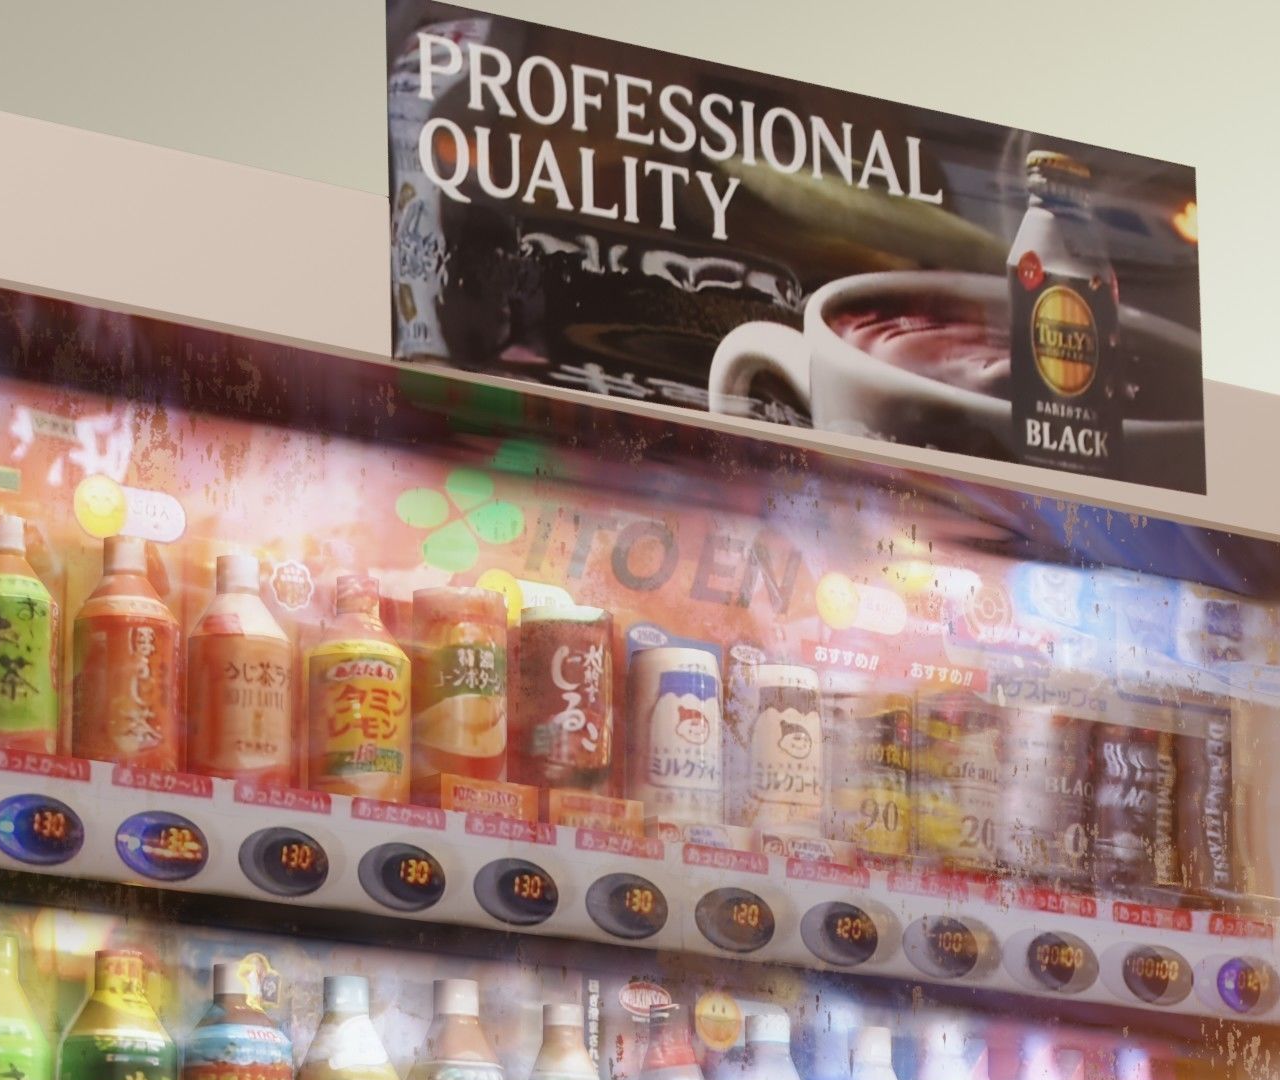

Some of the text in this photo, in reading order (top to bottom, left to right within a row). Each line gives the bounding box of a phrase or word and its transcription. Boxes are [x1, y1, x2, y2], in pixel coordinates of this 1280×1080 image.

[417, 33, 943, 205] PROFESSIONAL
[418, 115, 740, 241] QUALITY
[1026, 418, 1109, 457] BLACK
[525, 505, 803, 616] ITO EN
[34, 811, 66, 838] 130
[859, 797, 899, 833] 90
[281, 843, 312, 869] 130
[400, 859, 430, 886] 130
[514, 874, 541, 899] 130
[625, 889, 652, 913] 130
[733, 904, 760, 927] 120
[938, 931, 962, 953] 100
